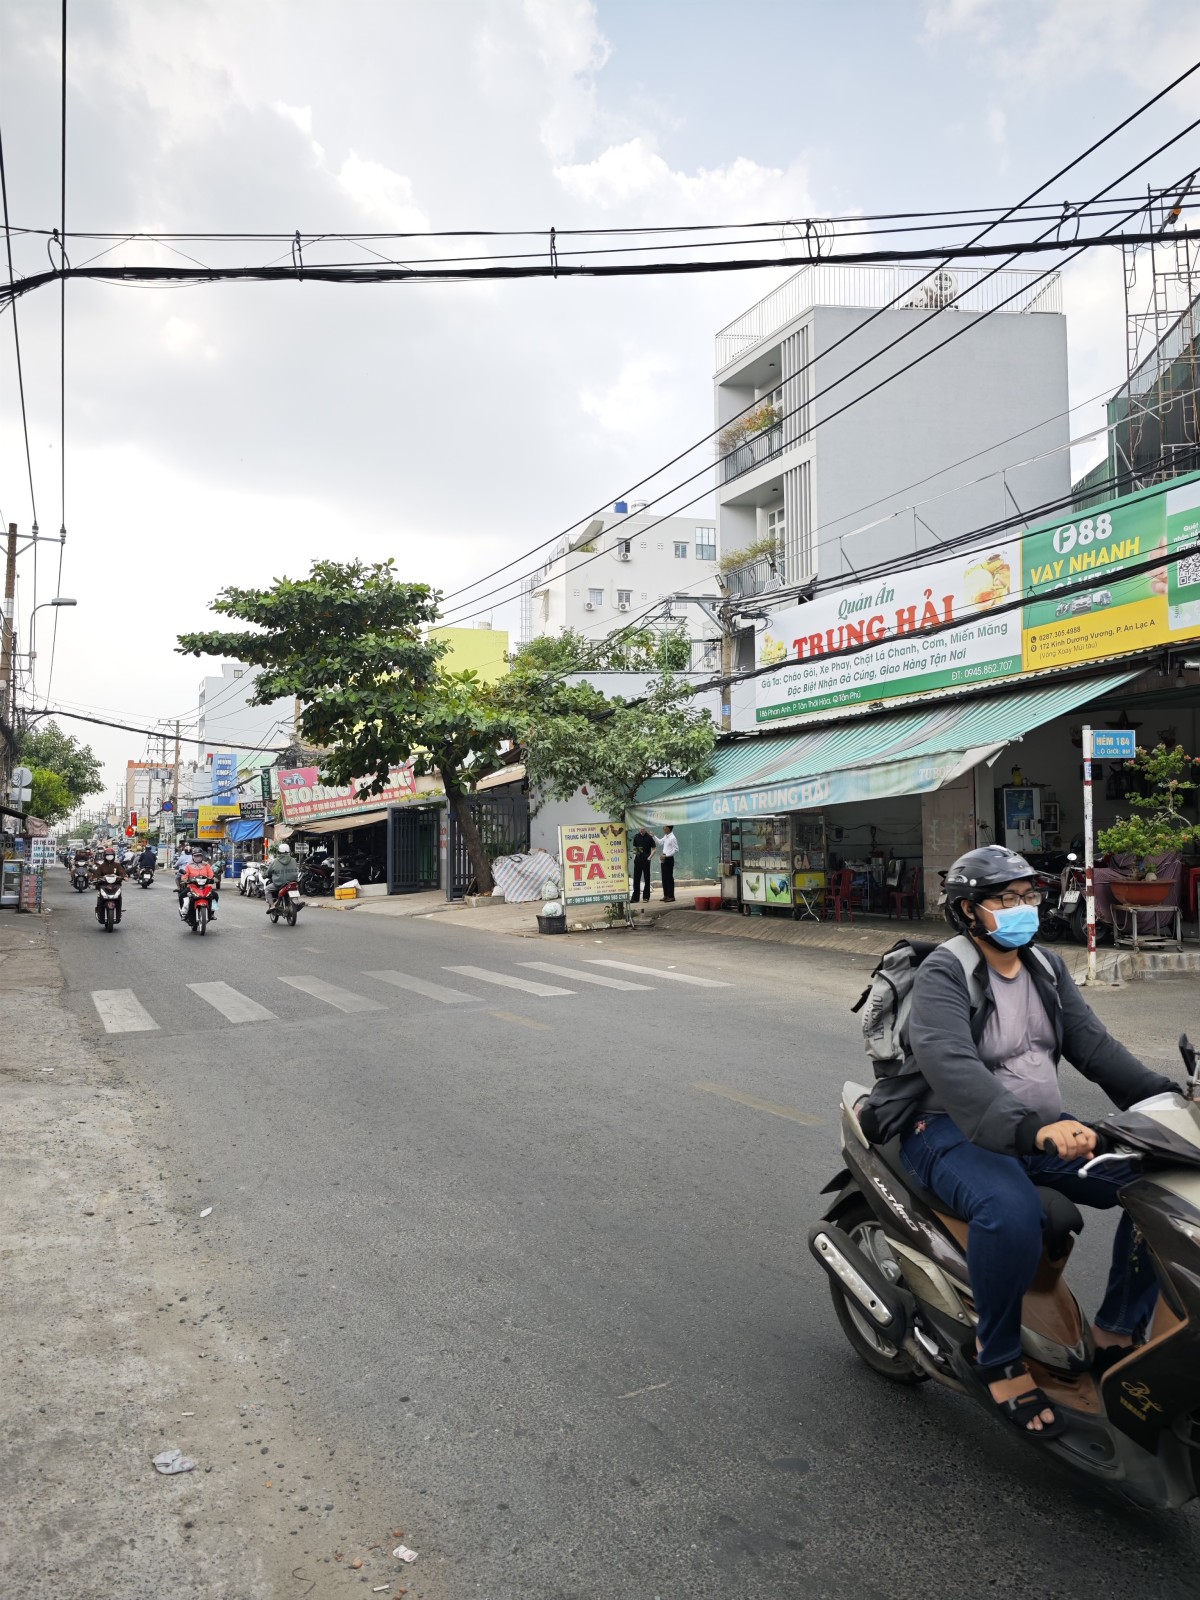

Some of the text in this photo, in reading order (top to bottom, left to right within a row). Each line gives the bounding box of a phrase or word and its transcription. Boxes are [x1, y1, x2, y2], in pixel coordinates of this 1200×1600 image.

[1053, 513, 1112, 554] F88
[1030, 536, 1140, 584] VAY NHANH
[838, 583, 895, 620] Quán Ăn
[793, 588, 954, 658] TRUNG HẢI
[1135, 622, 1148, 630] Lạc
[875, 650, 885, 661] Lá
[887, 645, 919, 658] Chanh,
[922, 639, 947, 650] Cơm,
[950, 628, 974, 644] Miến
[977, 623, 1008, 638] Măng
[803, 682, 817, 694] Biệt
[818, 677, 838, 690] Nhận
[839, 674, 851, 684] Gà
[879, 664, 900, 676] Giao
[902, 658, 927, 671] Hàng
[930, 653, 947, 668] Tận
[949, 648, 967, 662] Nơi
[964, 660, 1013, 678] 0945.852.707
[712, 795, 731, 815] GÀ
[732, 796, 748, 812] TA
[750, 787, 799, 809] TRUNG
[566, 841, 605, 862] GÀ
[569, 863, 606, 881] TA
